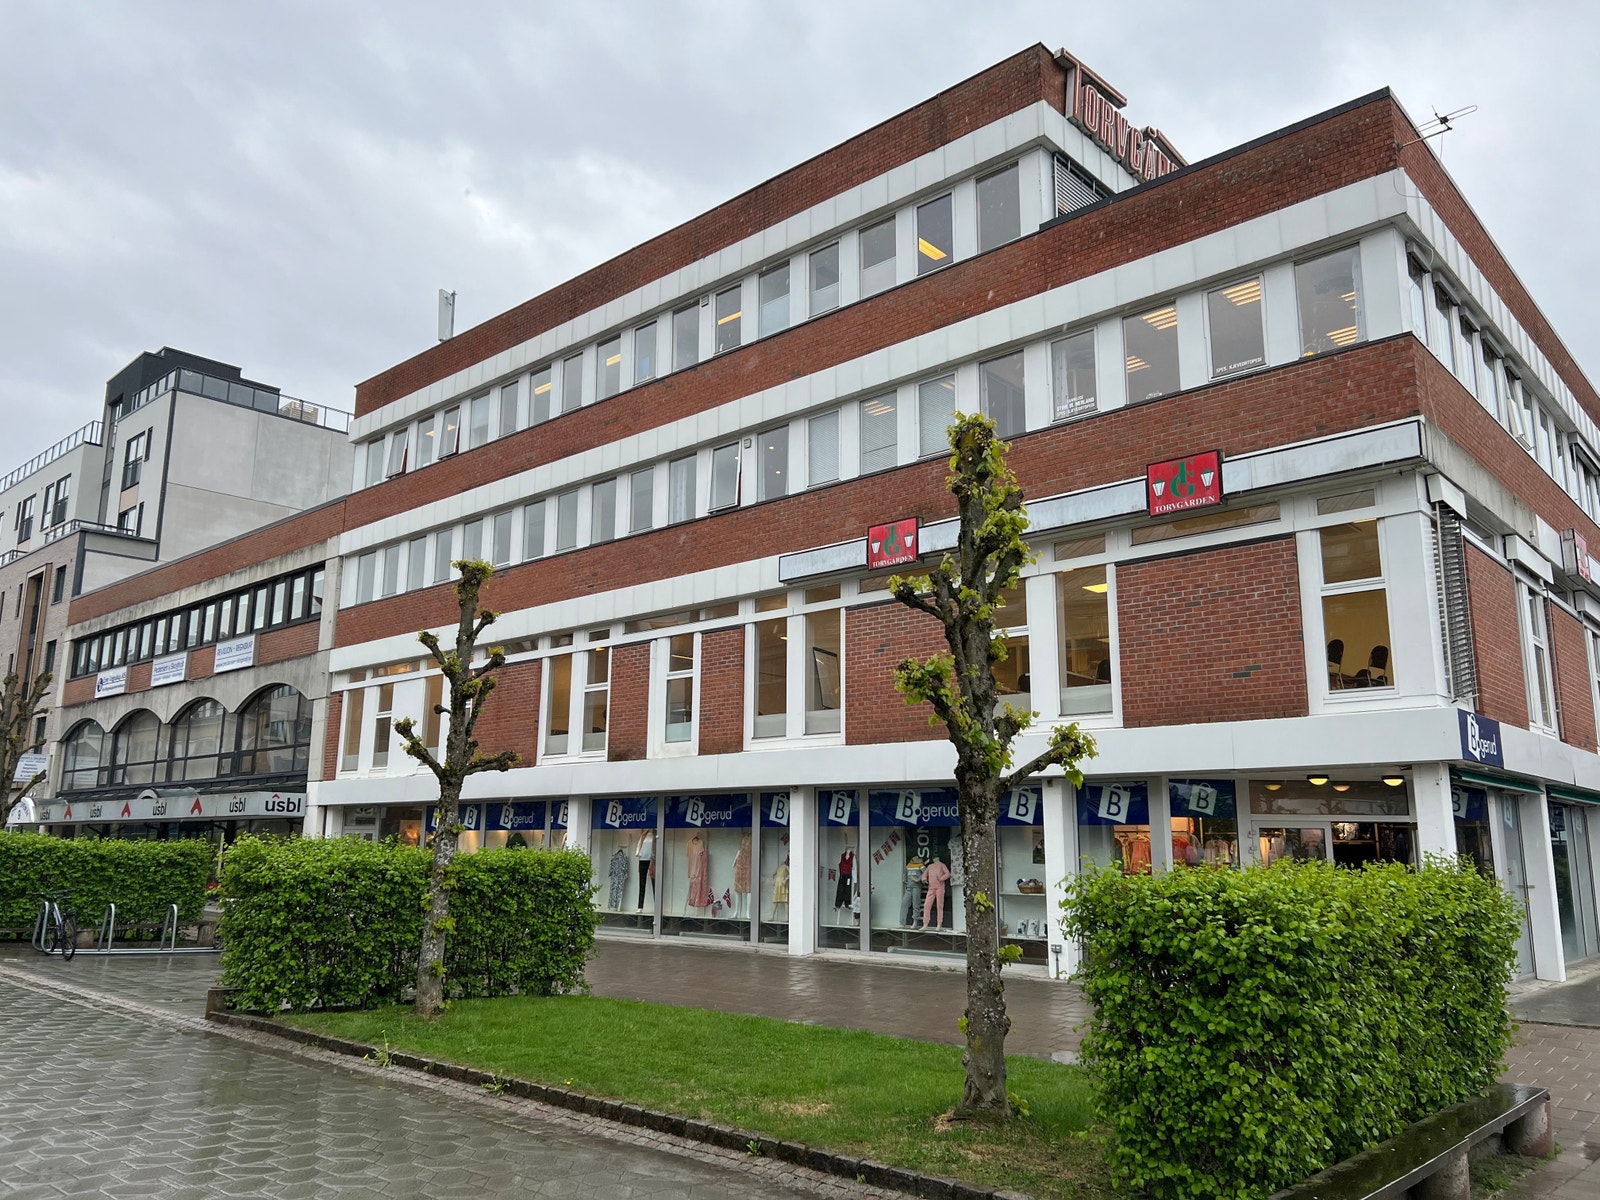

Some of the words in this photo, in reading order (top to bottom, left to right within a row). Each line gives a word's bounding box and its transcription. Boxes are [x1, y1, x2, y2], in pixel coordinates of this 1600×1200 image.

[1471, 721, 1497, 759] Bogerud
[229, 797, 247, 813] usbl
[265, 796, 302, 813] usbl
[690, 799, 732, 825] Bogerud
[902, 795, 959, 822] Bogerud
[503, 808, 534, 828] Bogerud
[609, 805, 647, 825] Bogerud
